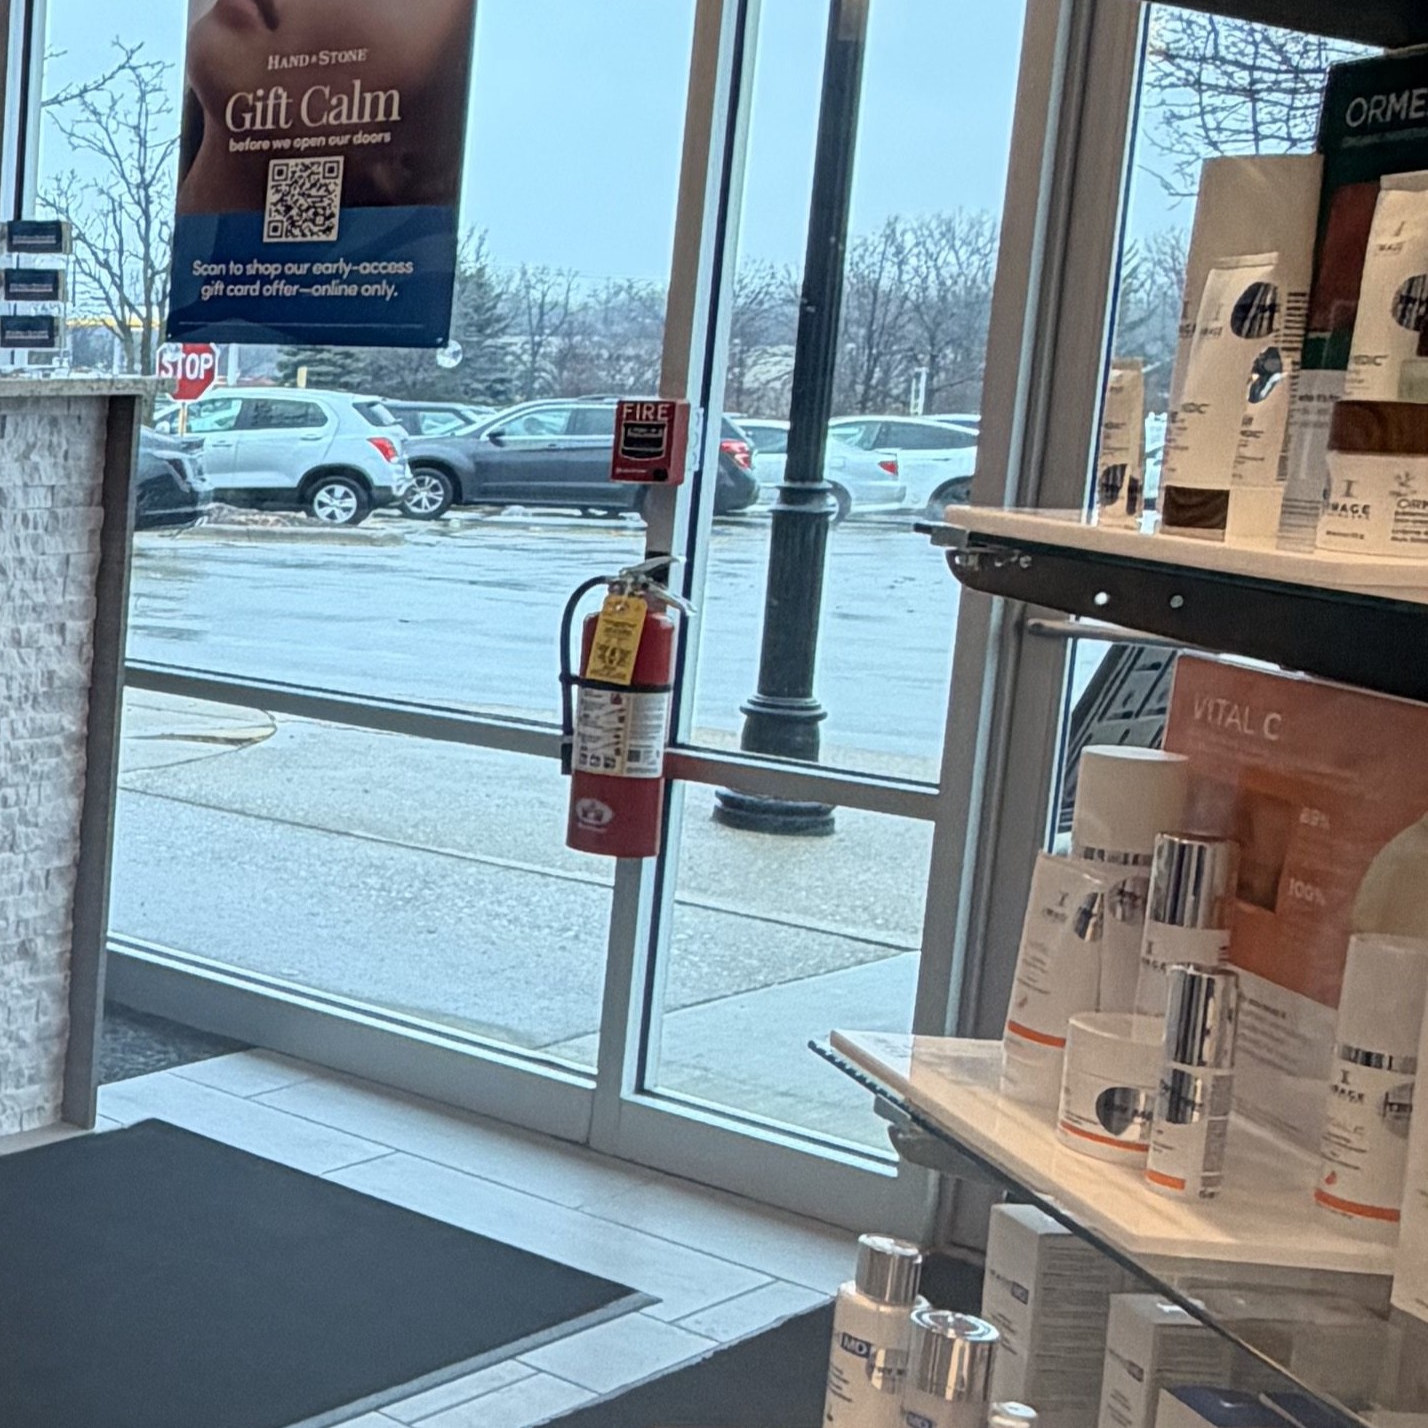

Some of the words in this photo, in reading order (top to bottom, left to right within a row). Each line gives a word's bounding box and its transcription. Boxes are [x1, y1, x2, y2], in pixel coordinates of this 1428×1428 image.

[267, 54, 309, 71] HAND
[318, 47, 369, 66] STONE
[225, 85, 294, 133] Gift
[300, 79, 402, 128] Calm
[228, 137, 271, 152] before
[272, 138, 292, 150] we
[293, 136, 326, 151] open
[328, 134, 351, 146] our
[353, 130, 392, 144] doors
[192, 260, 226, 276] Scan
[229, 260, 244, 276] to
[245, 259, 283, 279] shop
[284, 262, 311, 275] our
[312, 258, 414, 279] early-access
[200, 280, 225, 300] gift
[226, 280, 260, 296] card
[360, 280, 399, 301] only.
[160, 352, 214, 380] STOP
[623, 403, 671, 421] FIRE
[1194, 697, 1255, 735] VITAL
[1263, 711, 1282, 741] C
[1289, 878, 1327, 907] 100%
[843, 1335, 869, 1356] MD
